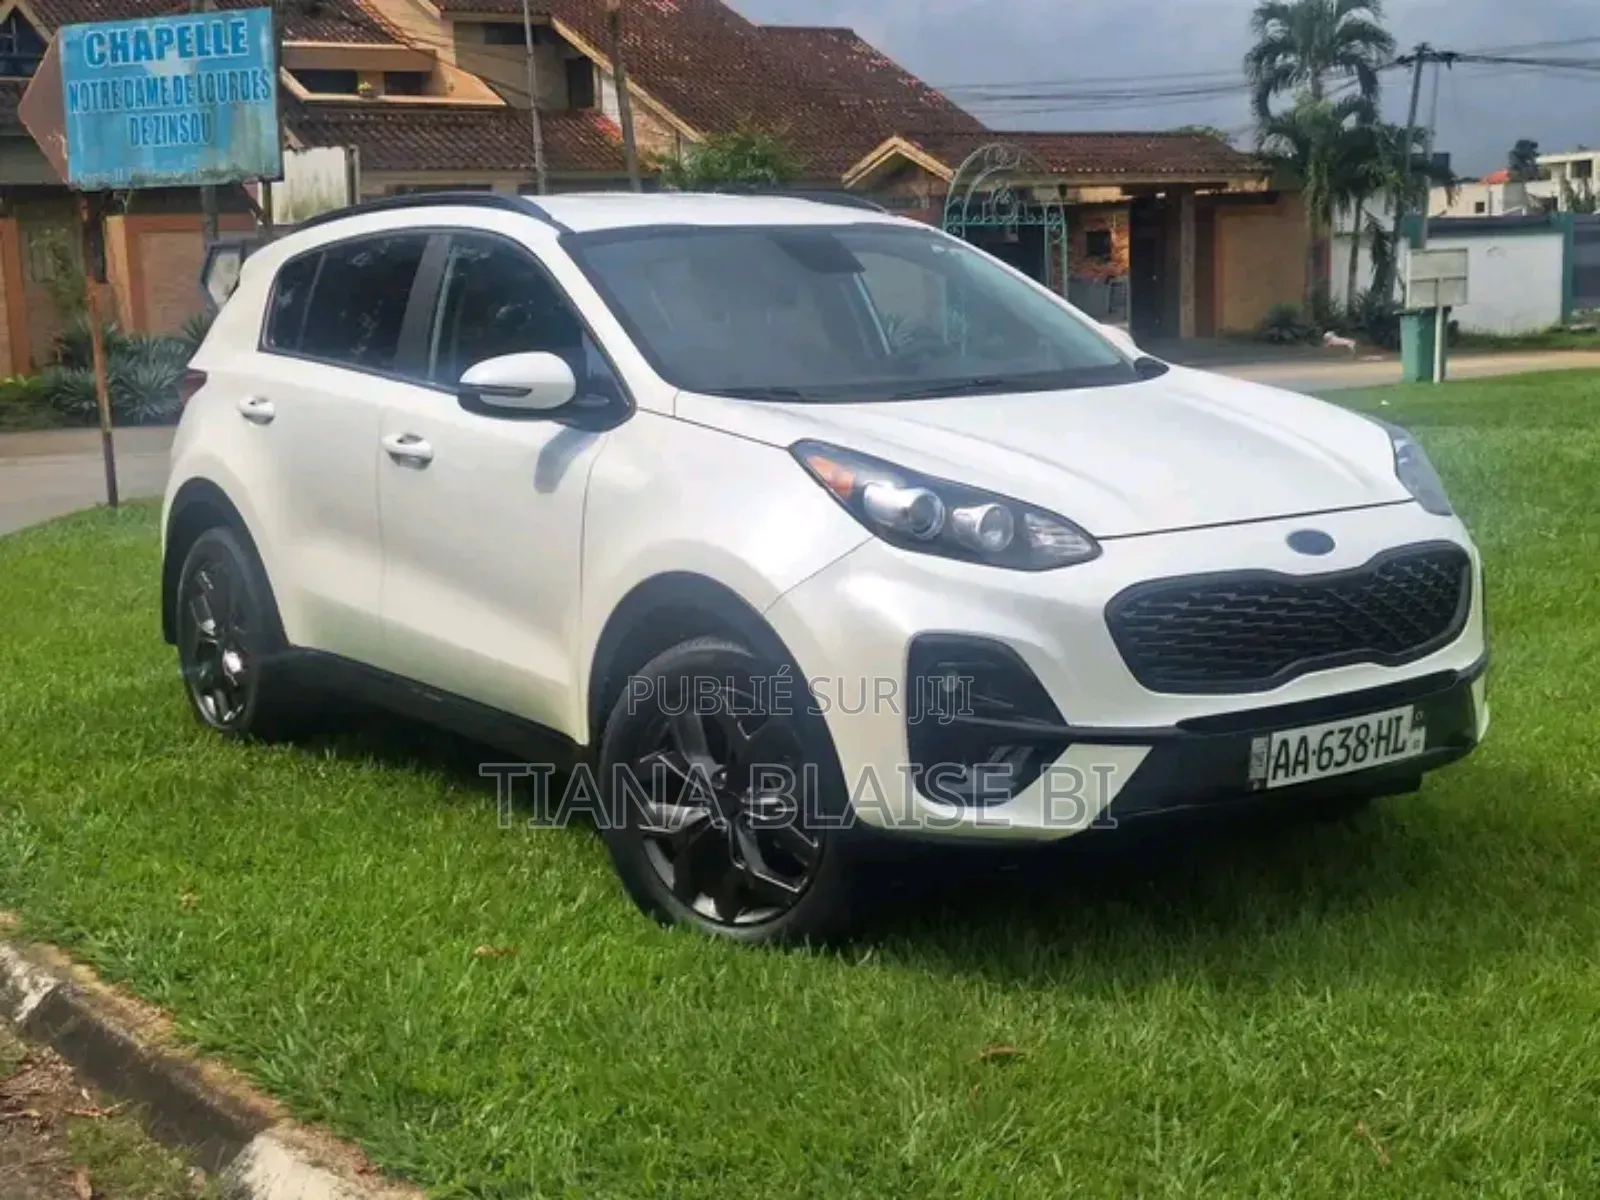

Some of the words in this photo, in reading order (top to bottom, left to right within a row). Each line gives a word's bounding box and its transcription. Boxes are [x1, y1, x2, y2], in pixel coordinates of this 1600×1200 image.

[84, 18, 249, 68] CHAPELLE
[67, 77, 120, 114] NOTRE
[123, 74, 169, 111] DAME
[172, 73, 194, 107] DE
[197, 67, 271, 105] LOURDES
[129, 115, 150, 147] DE
[151, 110, 214, 146] ZINSOU
